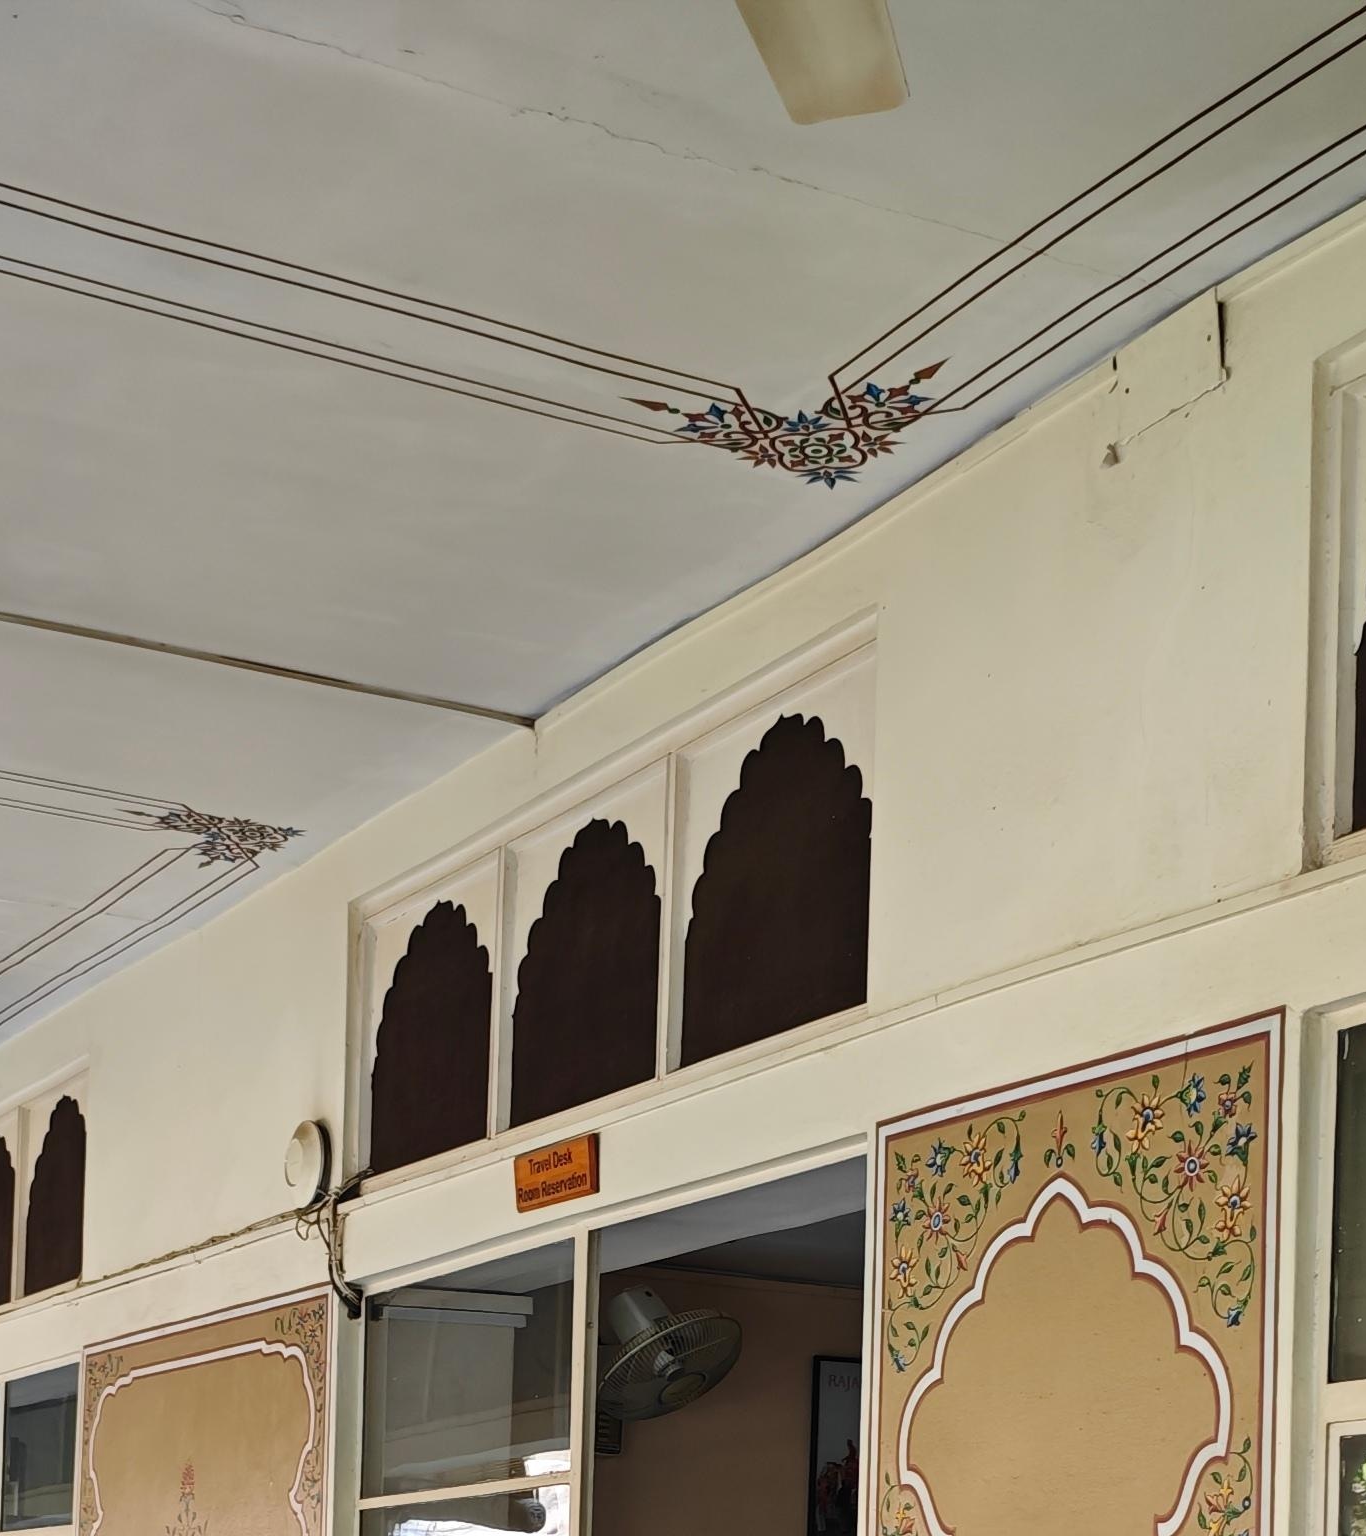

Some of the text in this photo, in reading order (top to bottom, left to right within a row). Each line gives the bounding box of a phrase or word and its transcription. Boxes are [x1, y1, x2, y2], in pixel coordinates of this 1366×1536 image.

[528, 1148, 573, 1176] Travel Desk
[517, 1172, 587, 1203] Room Reservation
